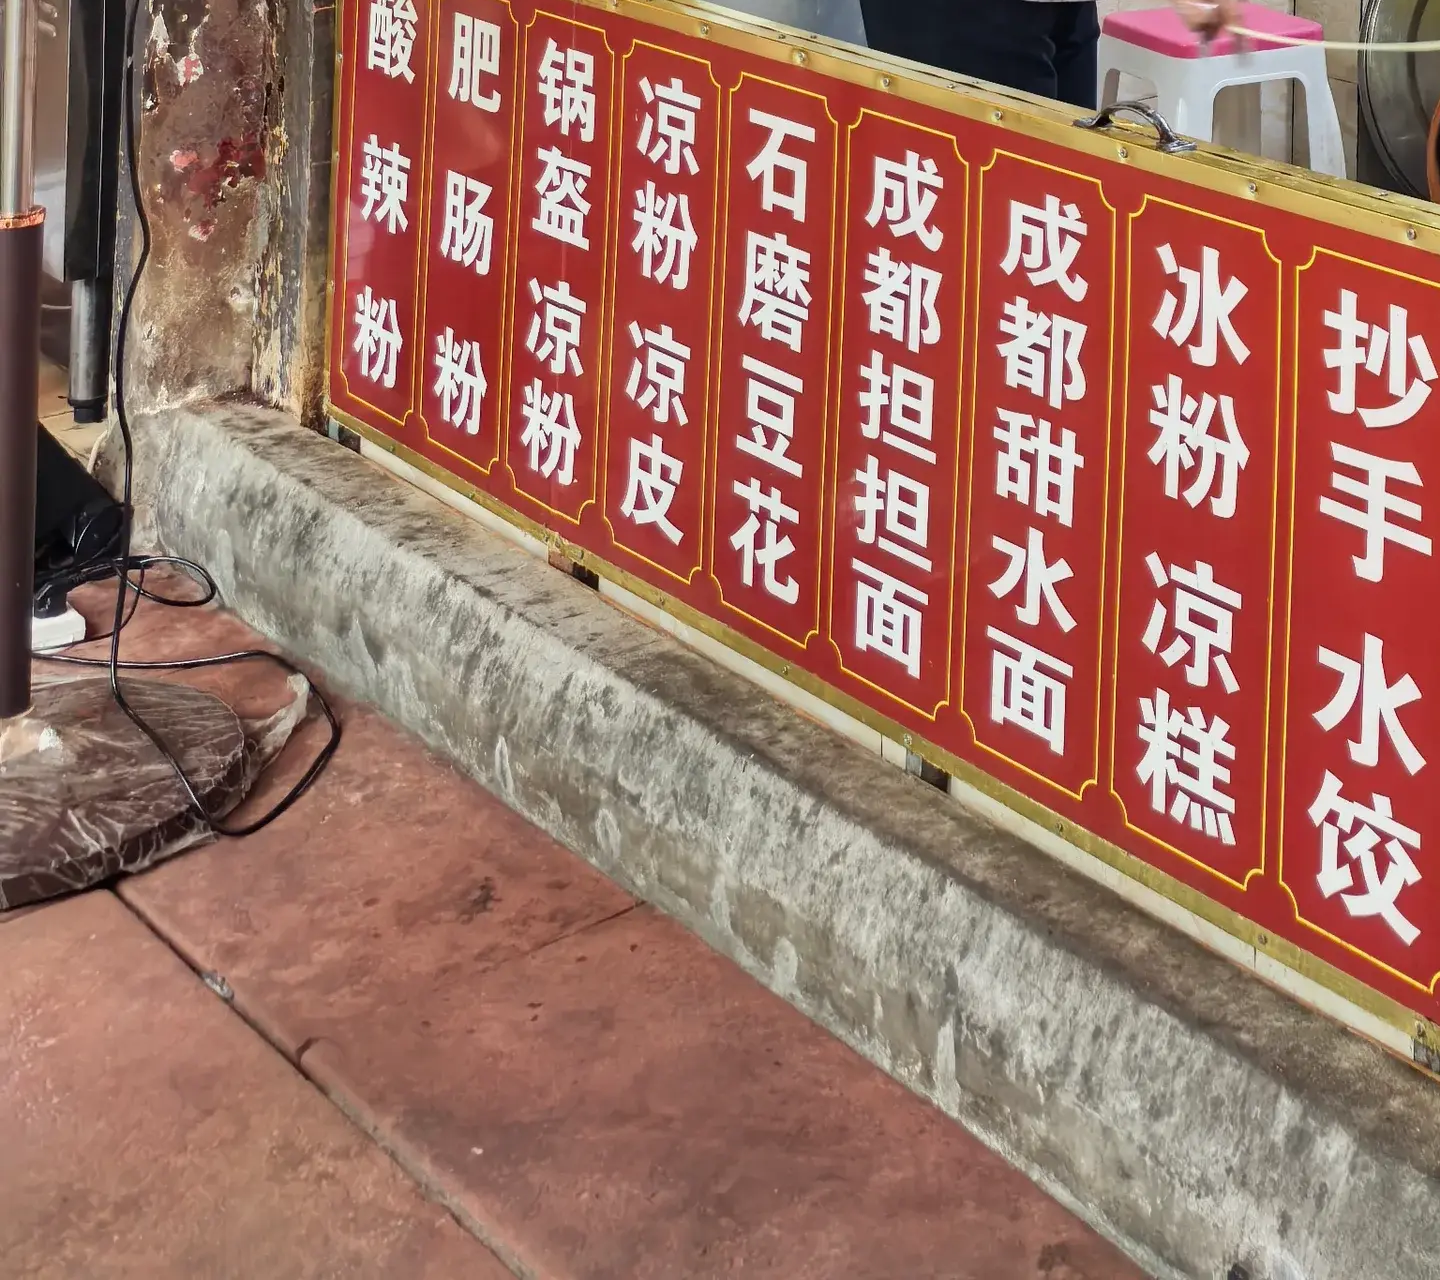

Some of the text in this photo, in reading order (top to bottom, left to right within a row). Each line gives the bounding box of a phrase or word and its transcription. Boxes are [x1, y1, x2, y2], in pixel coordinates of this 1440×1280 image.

[434, 12, 501, 435] 肥肠粉
[730, 108, 815, 604] 石磨豆花
[852, 150, 943, 679] 成都担担面
[987, 194, 1088, 755] 成都甜水面
